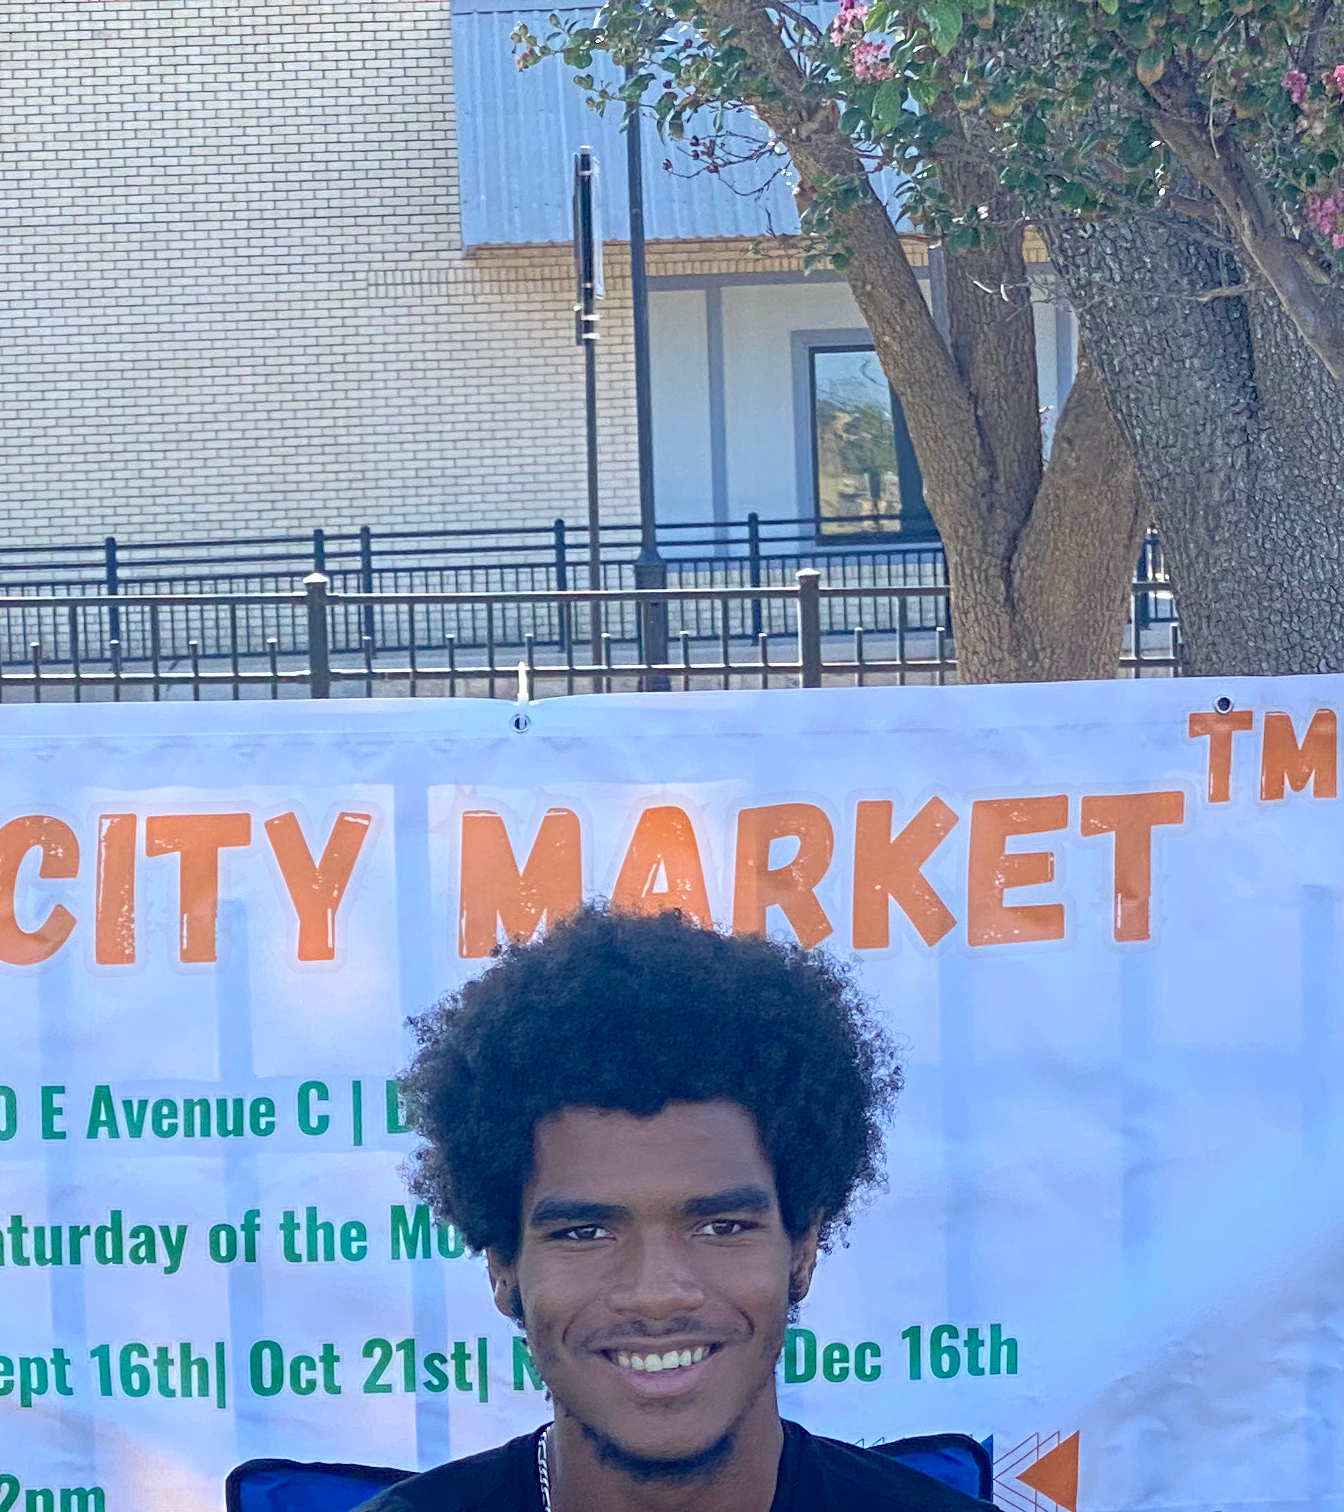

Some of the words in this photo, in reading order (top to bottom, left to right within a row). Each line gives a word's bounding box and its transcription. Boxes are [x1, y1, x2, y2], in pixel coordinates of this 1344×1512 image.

[458, 790, 1185, 958] MARKET
[1188, 708, 1338, 803] TM
[40, 1085, 67, 1141] E
[85, 1084, 277, 1140] Avenue
[296, 1080, 331, 1136] C
[209, 1208, 261, 1264] of
[280, 1206, 369, 1263] the
[390, 1203, 468, 1261] Mo
[249, 1338, 343, 1397] Oct
[784, 1327, 882, 1384] Dec
[901, 1323, 1019, 1381] 16th
